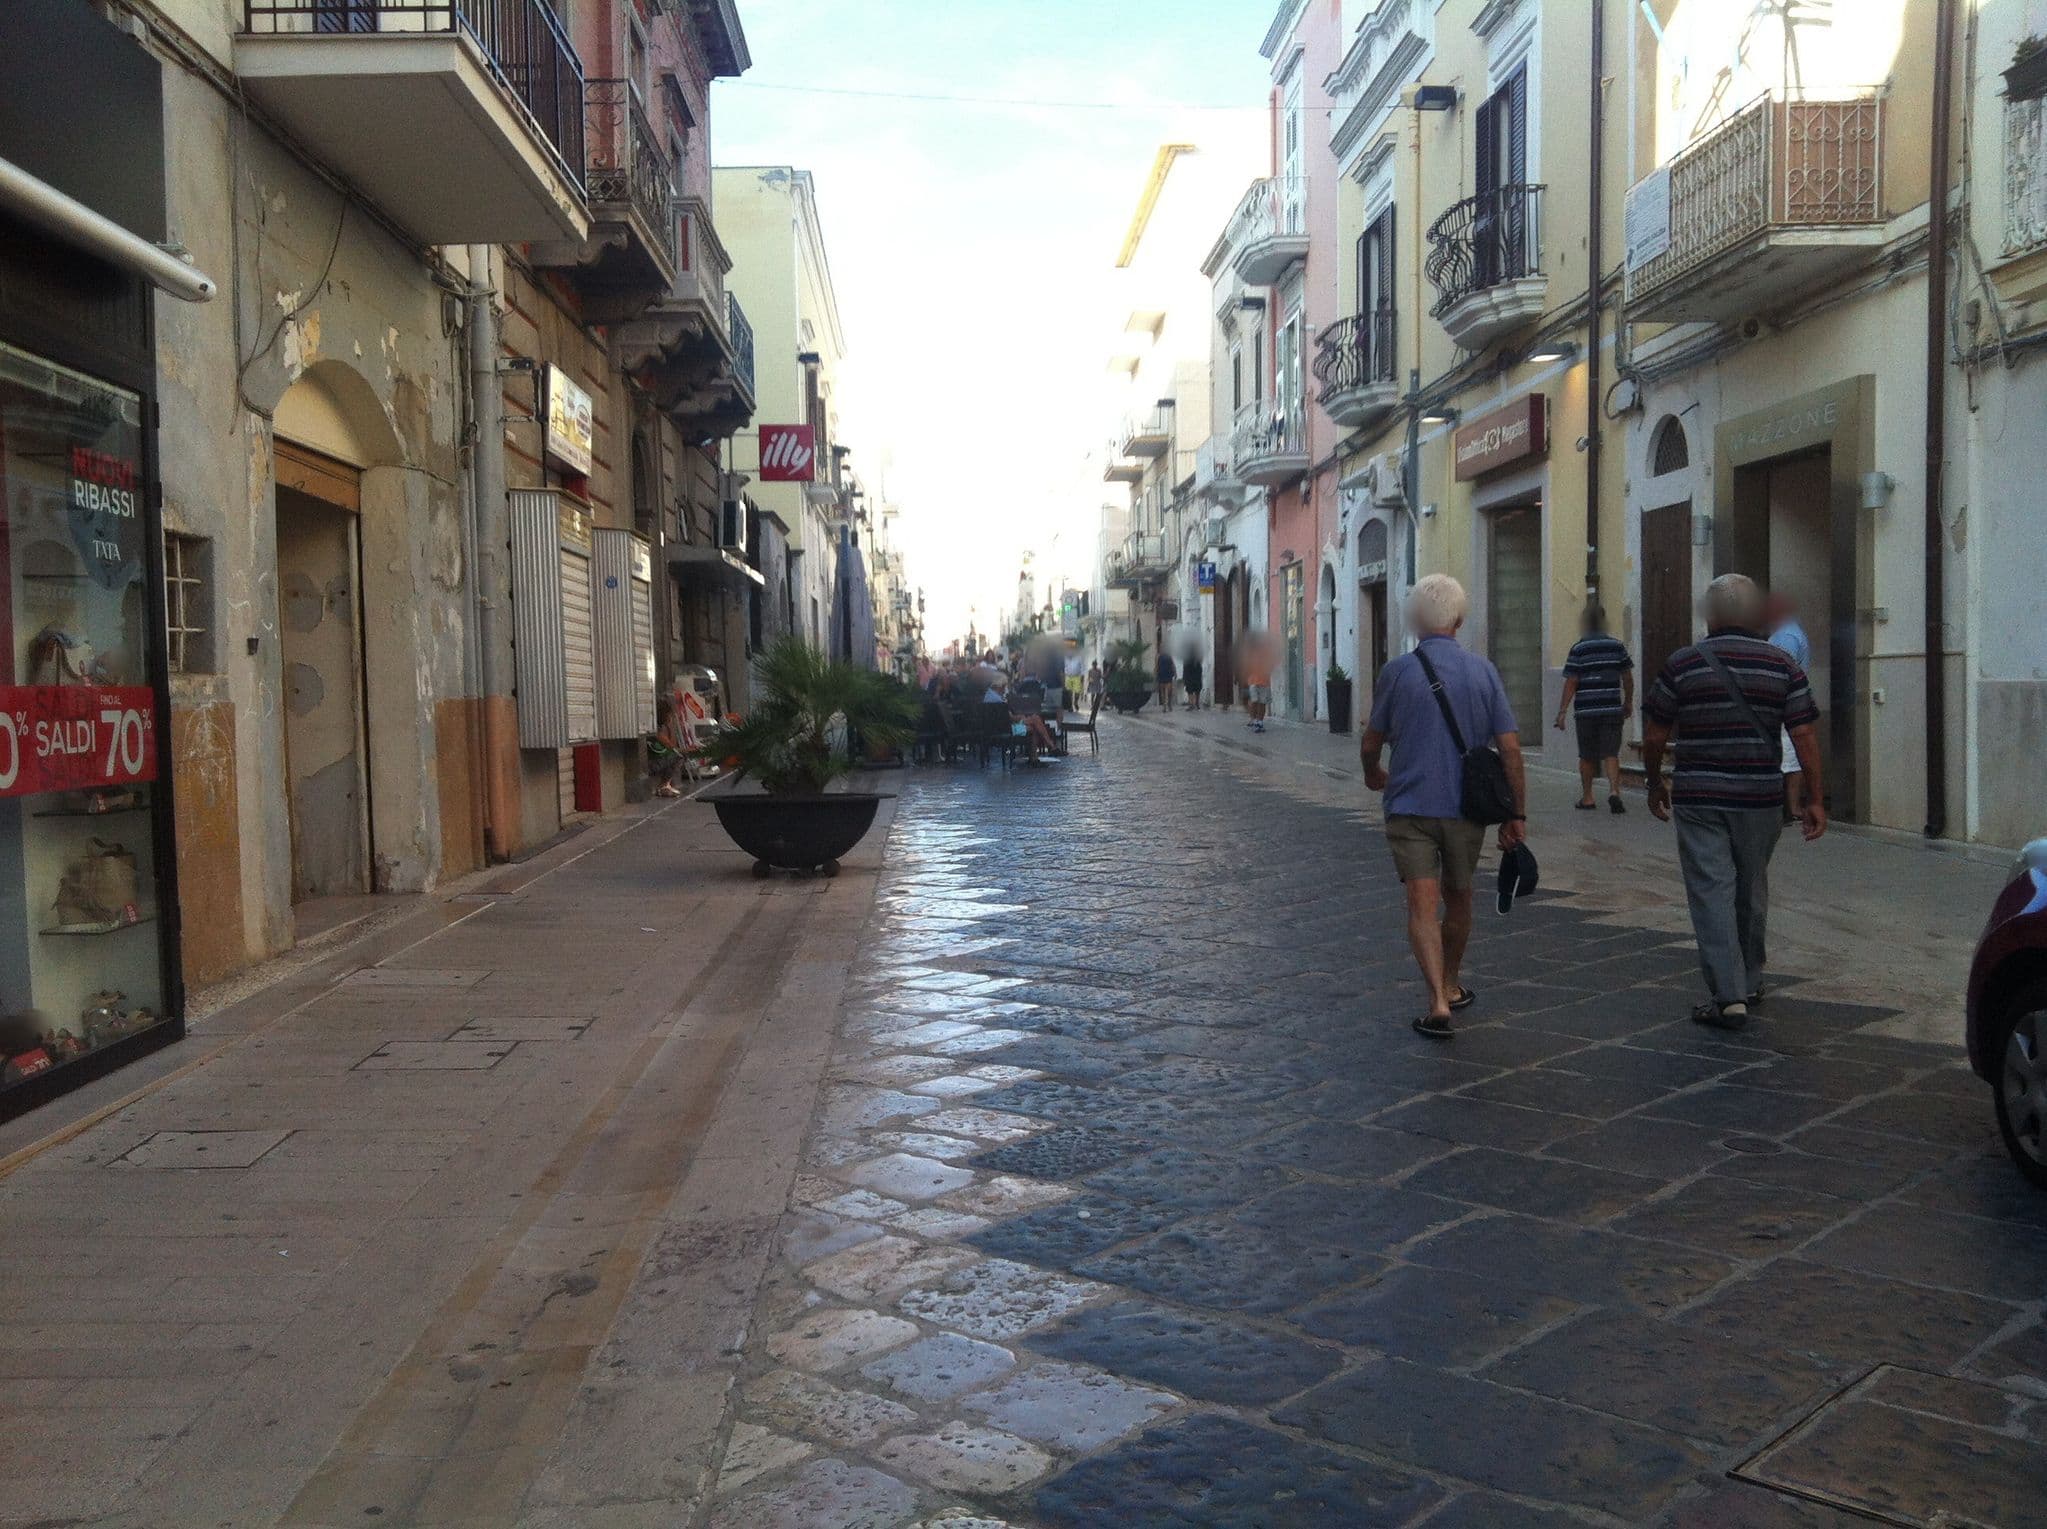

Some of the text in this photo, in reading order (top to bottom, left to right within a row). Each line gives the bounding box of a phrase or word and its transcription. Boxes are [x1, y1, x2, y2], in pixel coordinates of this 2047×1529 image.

[762, 433, 813, 475] illy
[74, 479, 136, 519] RIBASSI
[36, 720, 96, 757] SALDI
[100, 708, 152, 777] 70%
